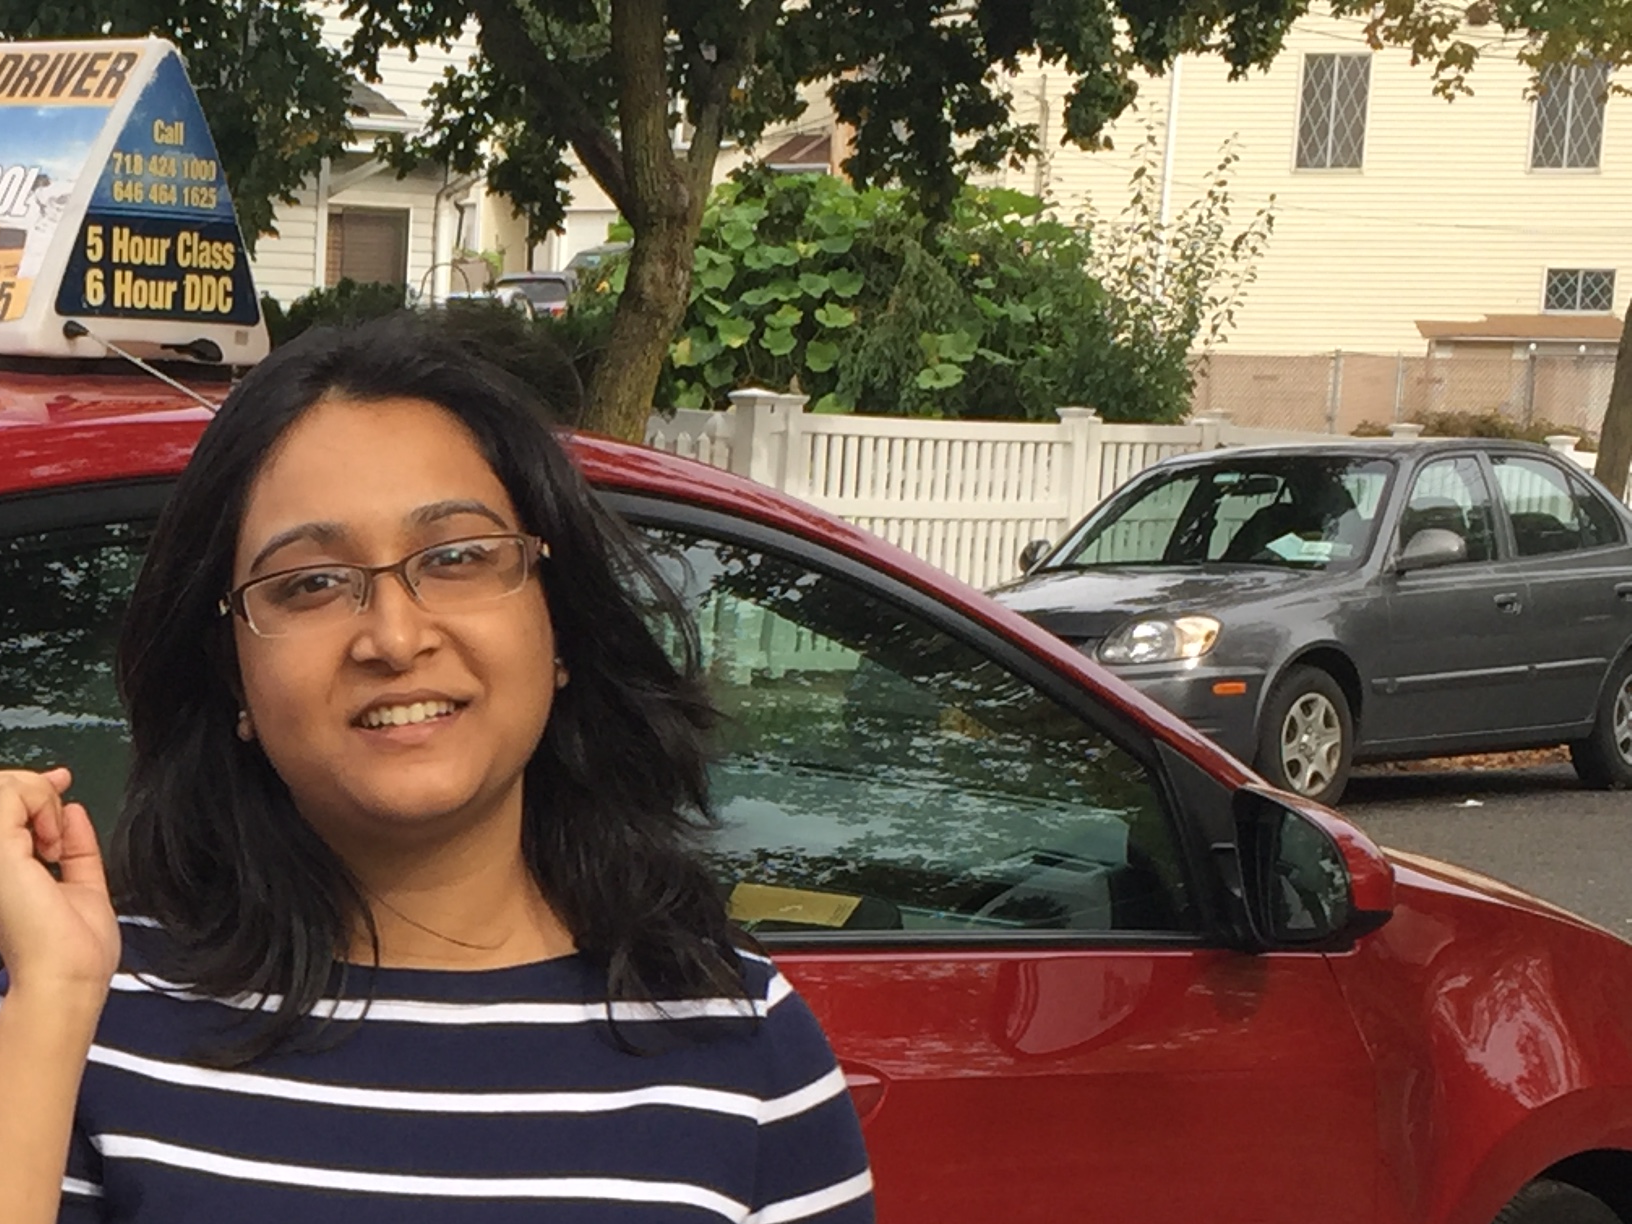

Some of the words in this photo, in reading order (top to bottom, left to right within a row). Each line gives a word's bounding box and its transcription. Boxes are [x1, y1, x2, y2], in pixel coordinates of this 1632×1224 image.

[153, 118, 185, 145] Call
[113, 151, 143, 175] 718
[148, 155, 177, 178] 424
[183, 158, 217, 181] 1000
[113, 181, 143, 203] 646
[149, 183, 177, 206] 464
[183, 186, 217, 209] 1625
[86, 225, 104, 262] 5
[112, 226, 171, 266] Hour
[177, 231, 235, 271] Class
[85, 268, 105, 307] 6
[113, 269, 178, 310] Hour
[184, 274, 233, 314] DDC
